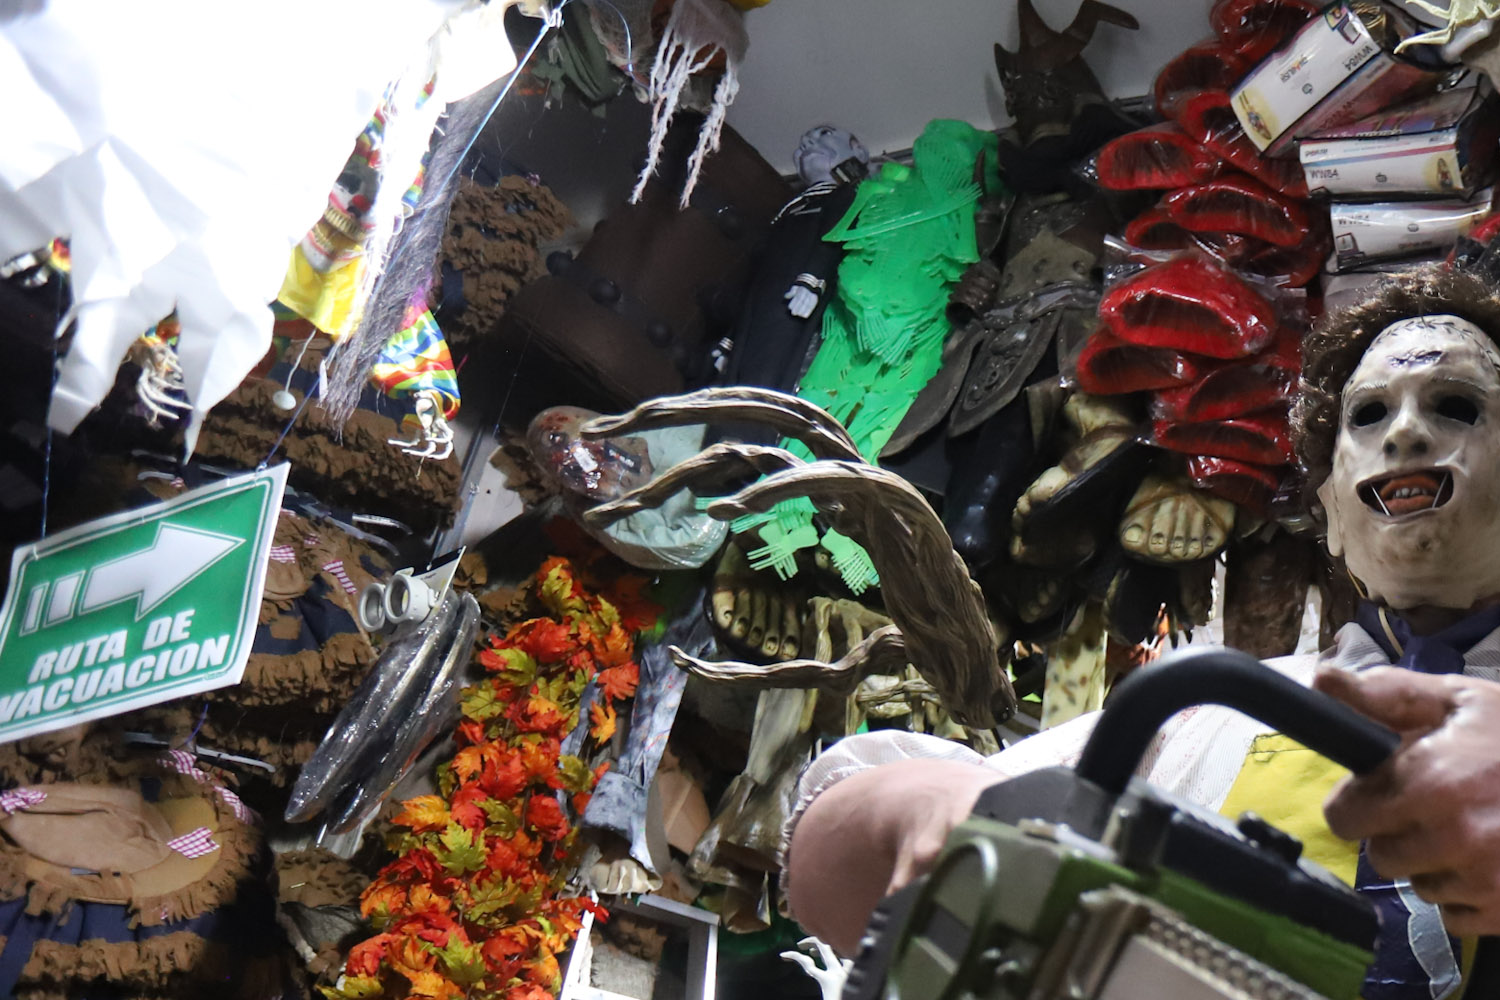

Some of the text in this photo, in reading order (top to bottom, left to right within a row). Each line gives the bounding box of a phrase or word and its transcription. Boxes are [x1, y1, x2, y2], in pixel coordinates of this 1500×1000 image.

[0, 635, 230, 723] VACUACION
[27, 609, 195, 684] RUTA DE
